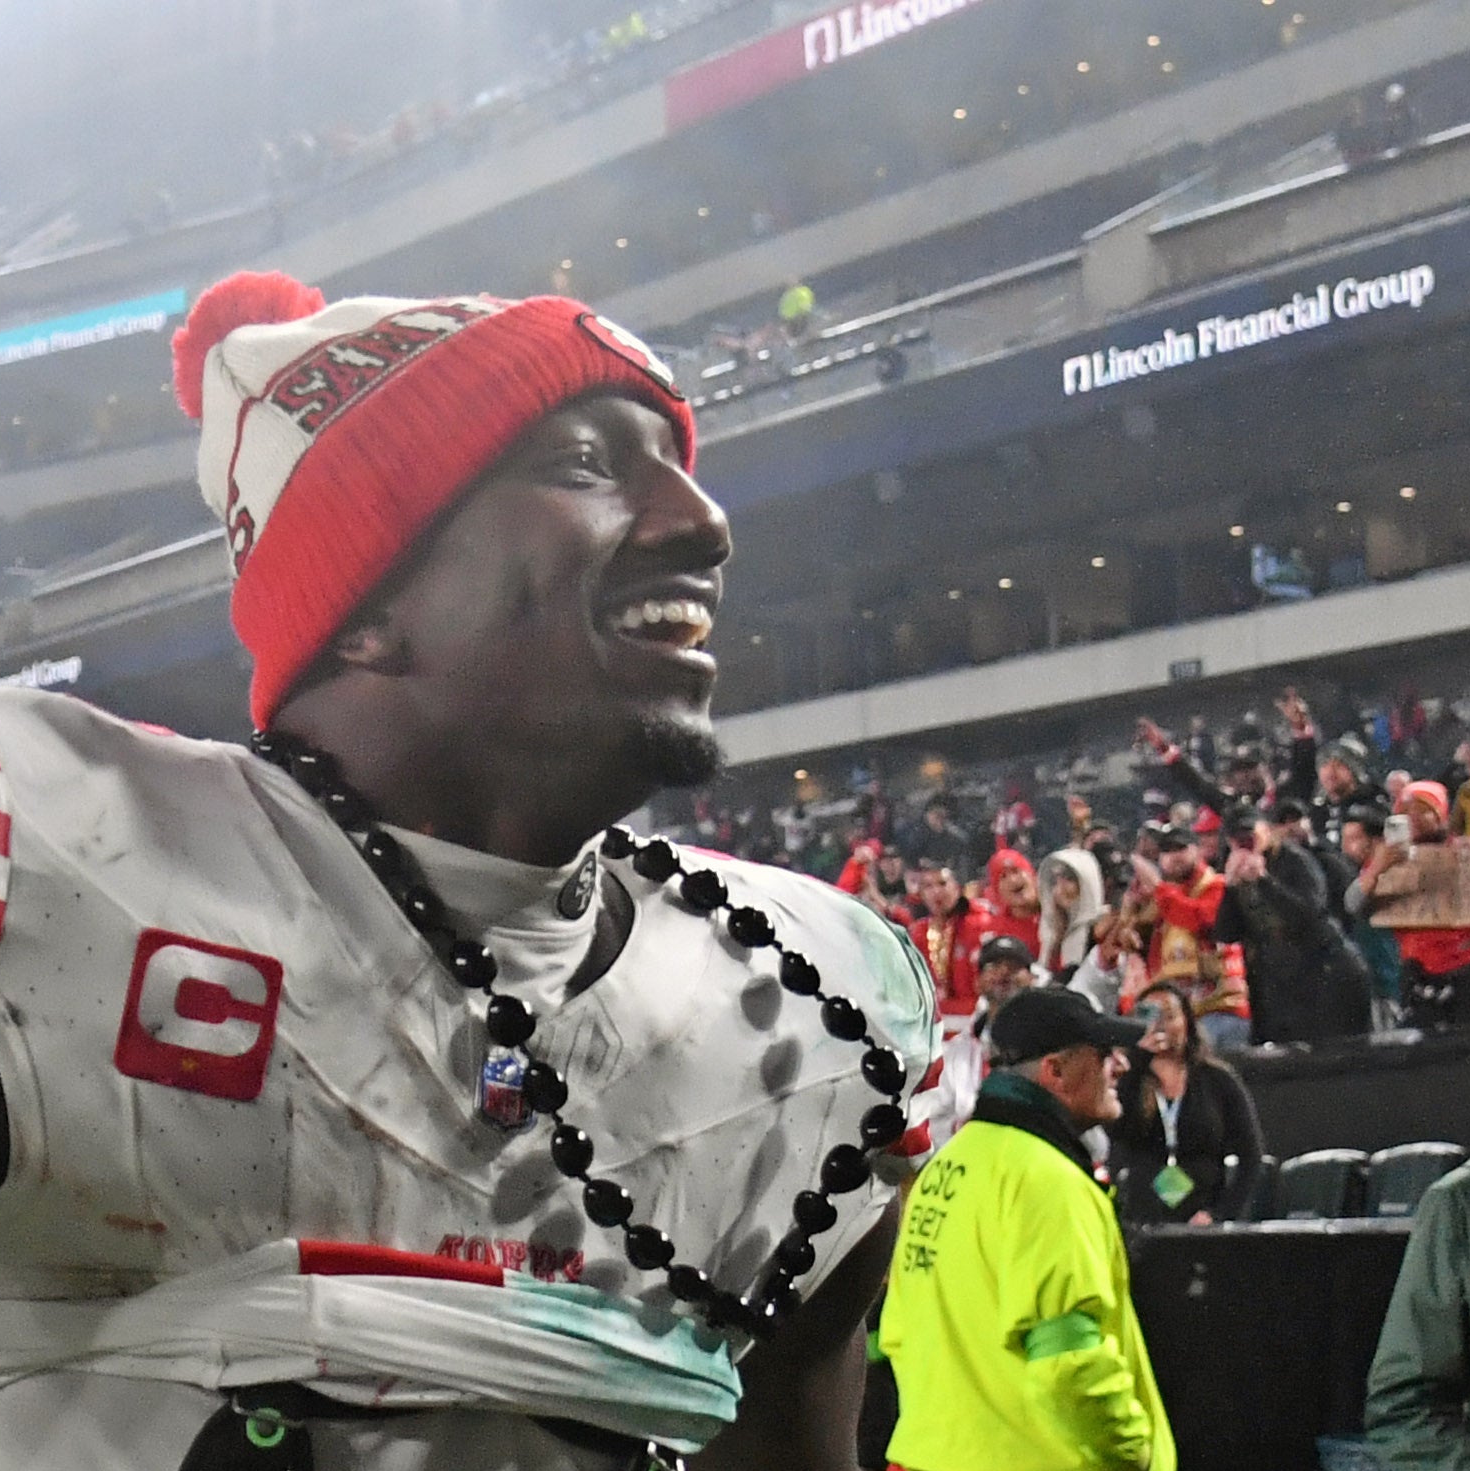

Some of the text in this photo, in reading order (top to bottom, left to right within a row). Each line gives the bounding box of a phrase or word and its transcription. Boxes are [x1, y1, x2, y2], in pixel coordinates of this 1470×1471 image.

[838, 0, 967, 57] Linco
[1092, 264, 1435, 388] Lincoln Financial Group
[136, 942, 268, 1059] C
